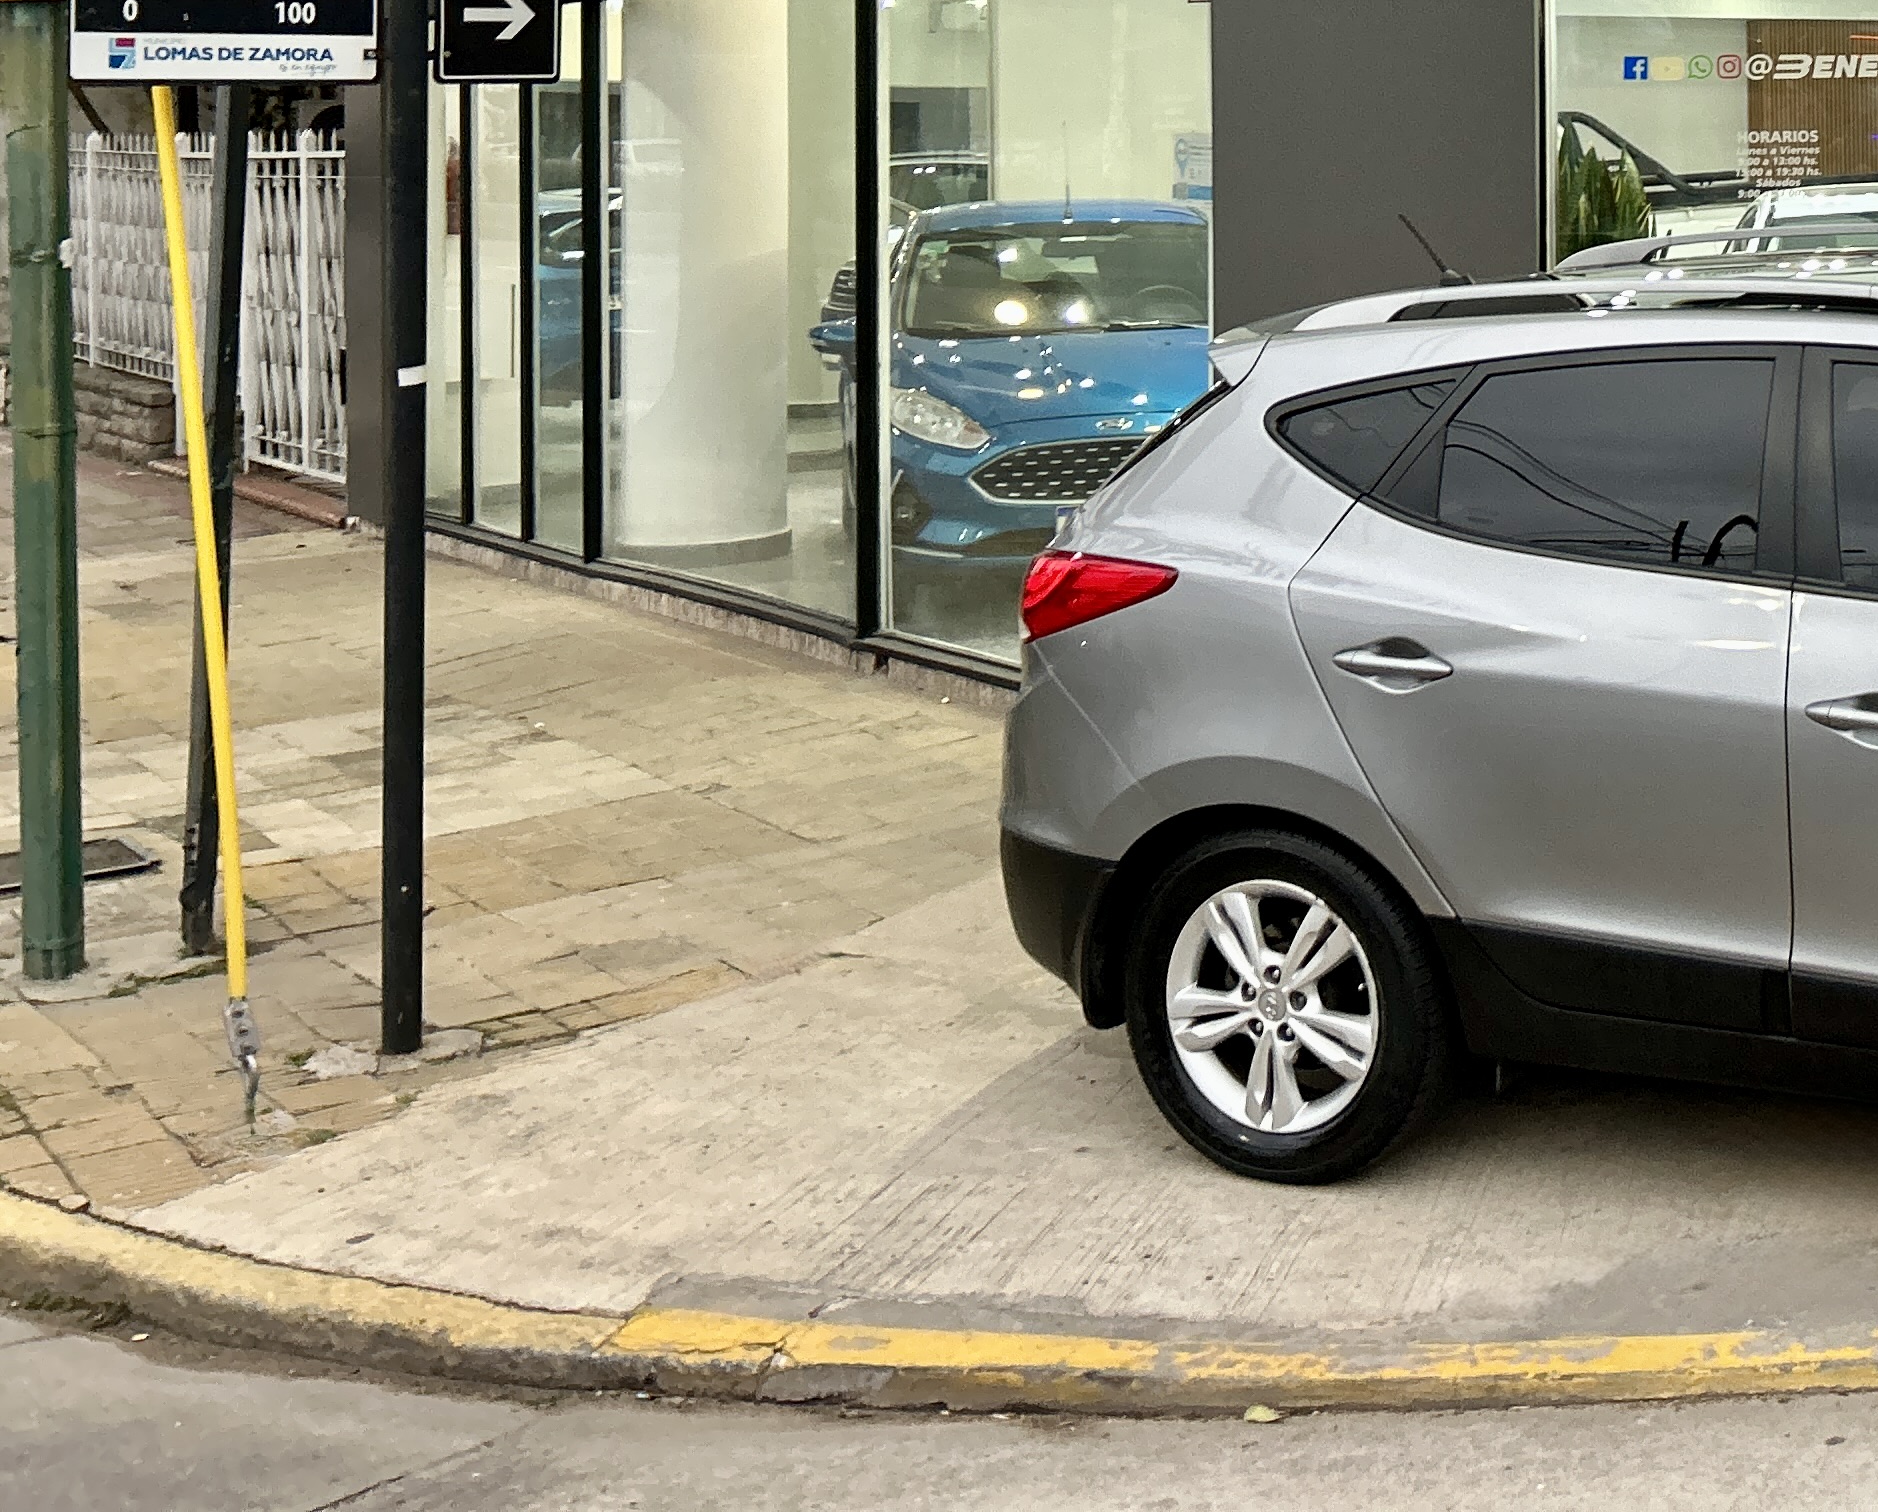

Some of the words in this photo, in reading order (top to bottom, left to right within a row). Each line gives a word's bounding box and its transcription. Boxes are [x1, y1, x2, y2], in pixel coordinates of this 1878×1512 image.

[274, 0, 317, 25] 100
[143, 46, 214, 62] LOMAS
[217, 46, 246, 62] DE
[249, 46, 334, 62] ZAMORA
[1737, 130, 1819, 144] HORARIOS
[1780, 146, 1820, 155] Viernes
